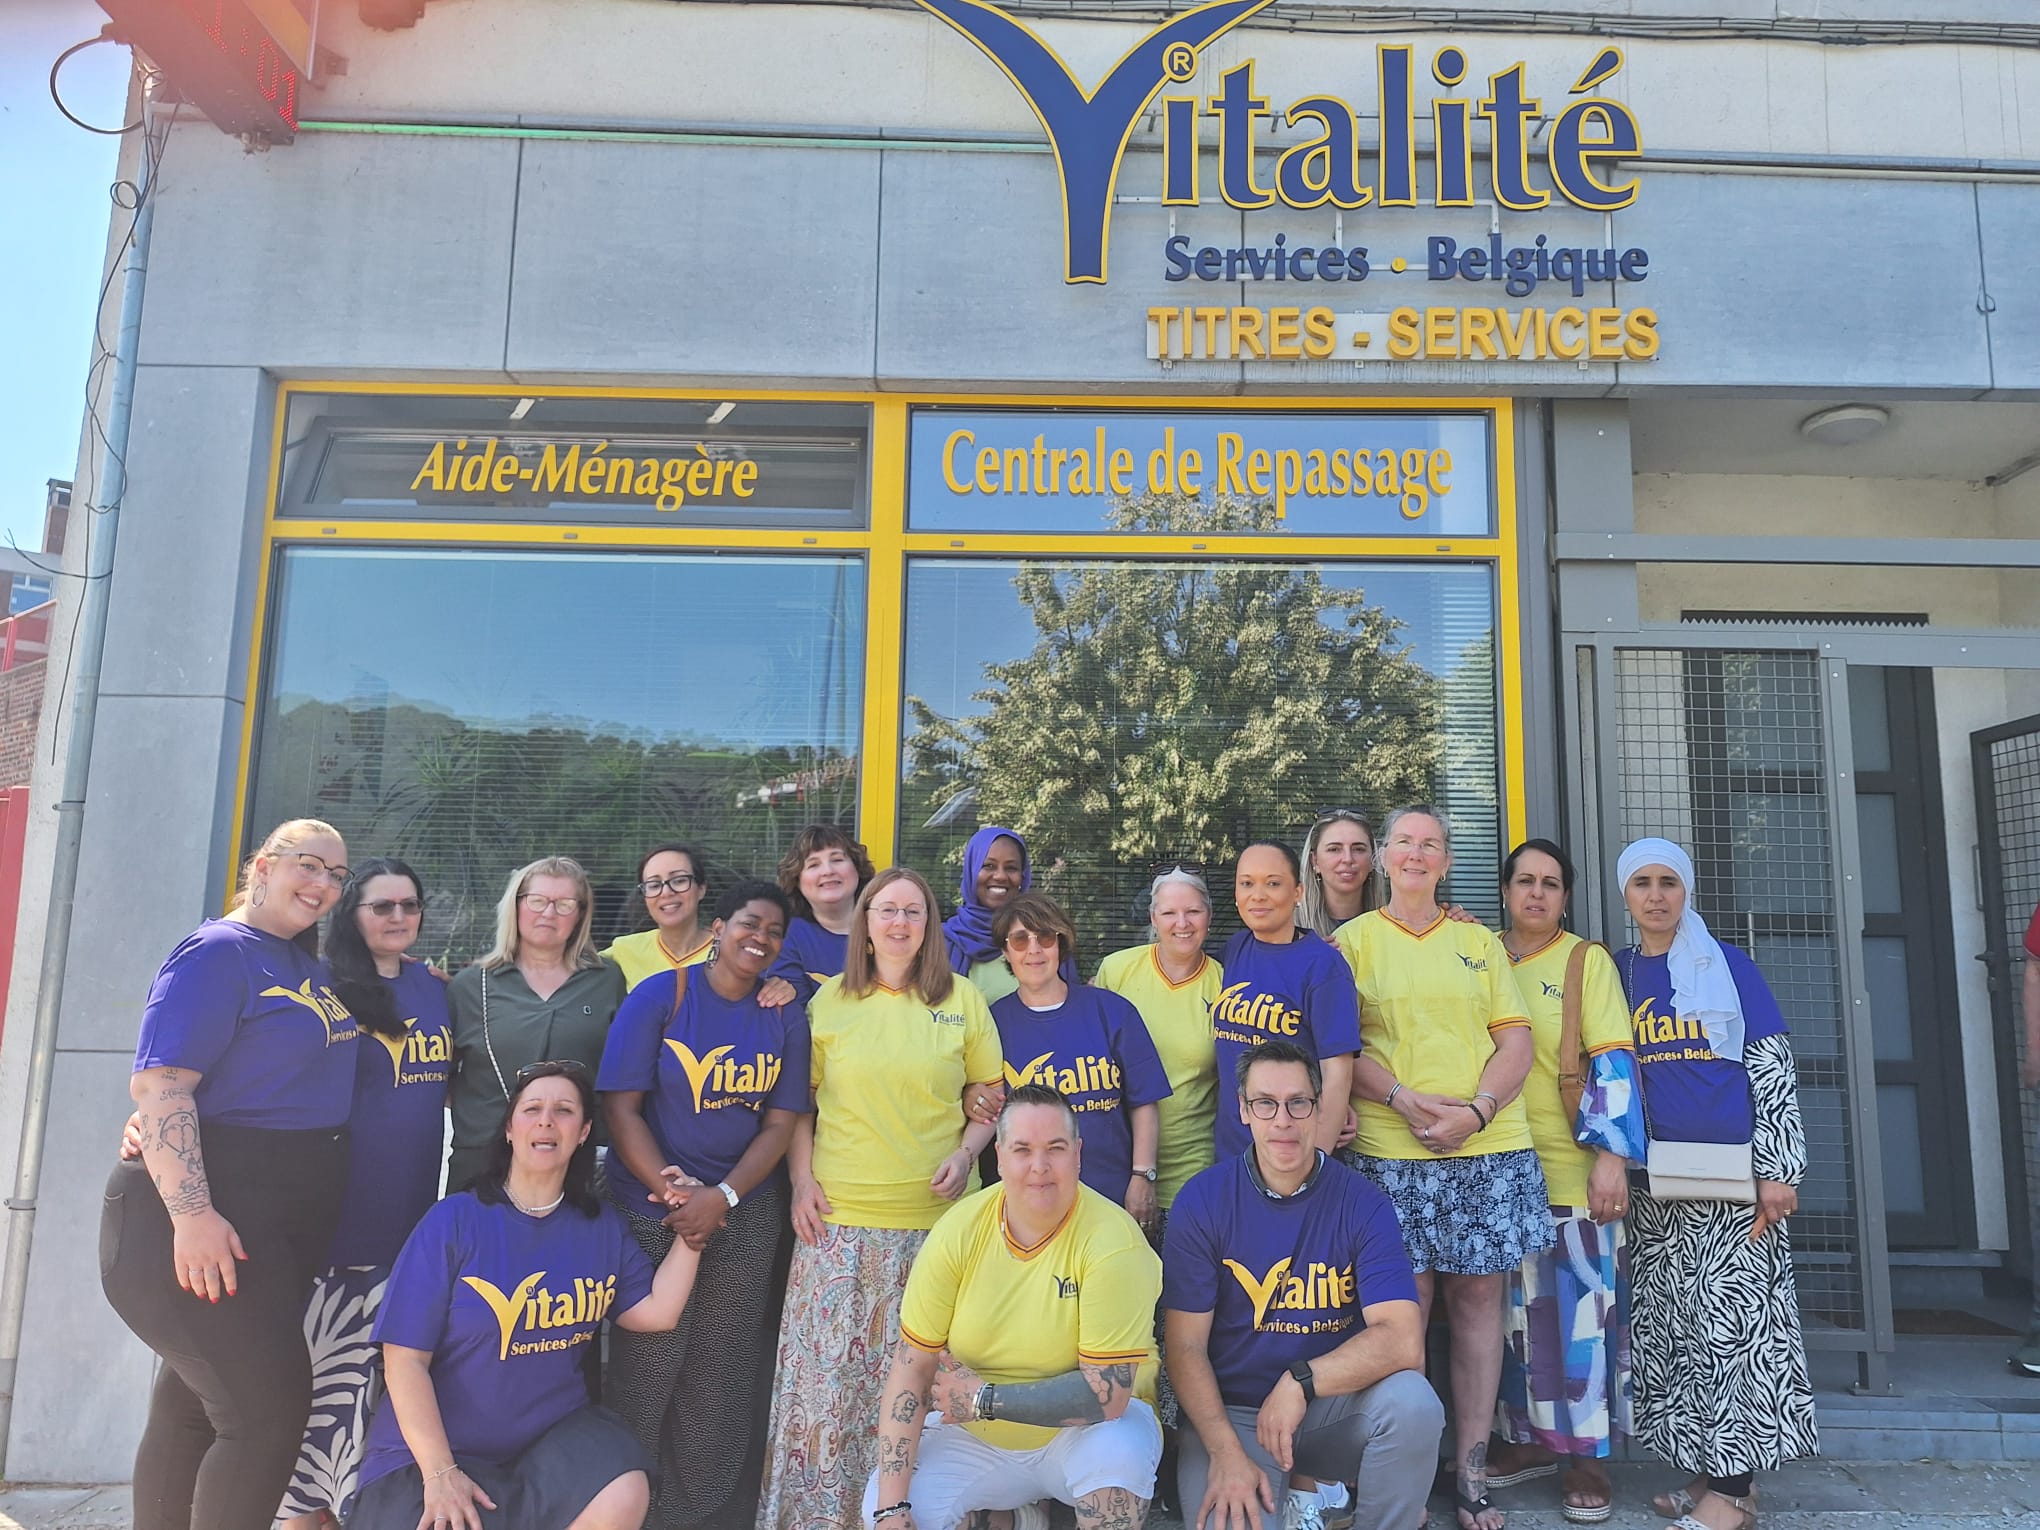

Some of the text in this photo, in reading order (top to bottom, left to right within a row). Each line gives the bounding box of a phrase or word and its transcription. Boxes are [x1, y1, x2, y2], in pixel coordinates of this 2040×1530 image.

[913, 0, 1643, 284] Vitalité
[1165, 233, 1369, 282] Services
[1427, 234, 1648, 297] Belgique
[1148, 306, 1337, 360] TITRES
[1387, 306, 1661, 360] SERVICES
[410, 437, 759, 512] Aide-Ménagère
[942, 426, 1453, 519] Centrale de Repassage
[358, 1017, 454, 1088] Vital
[460, 1271, 616, 1361] Vitalité
[511, 1338, 567, 1356] Services
